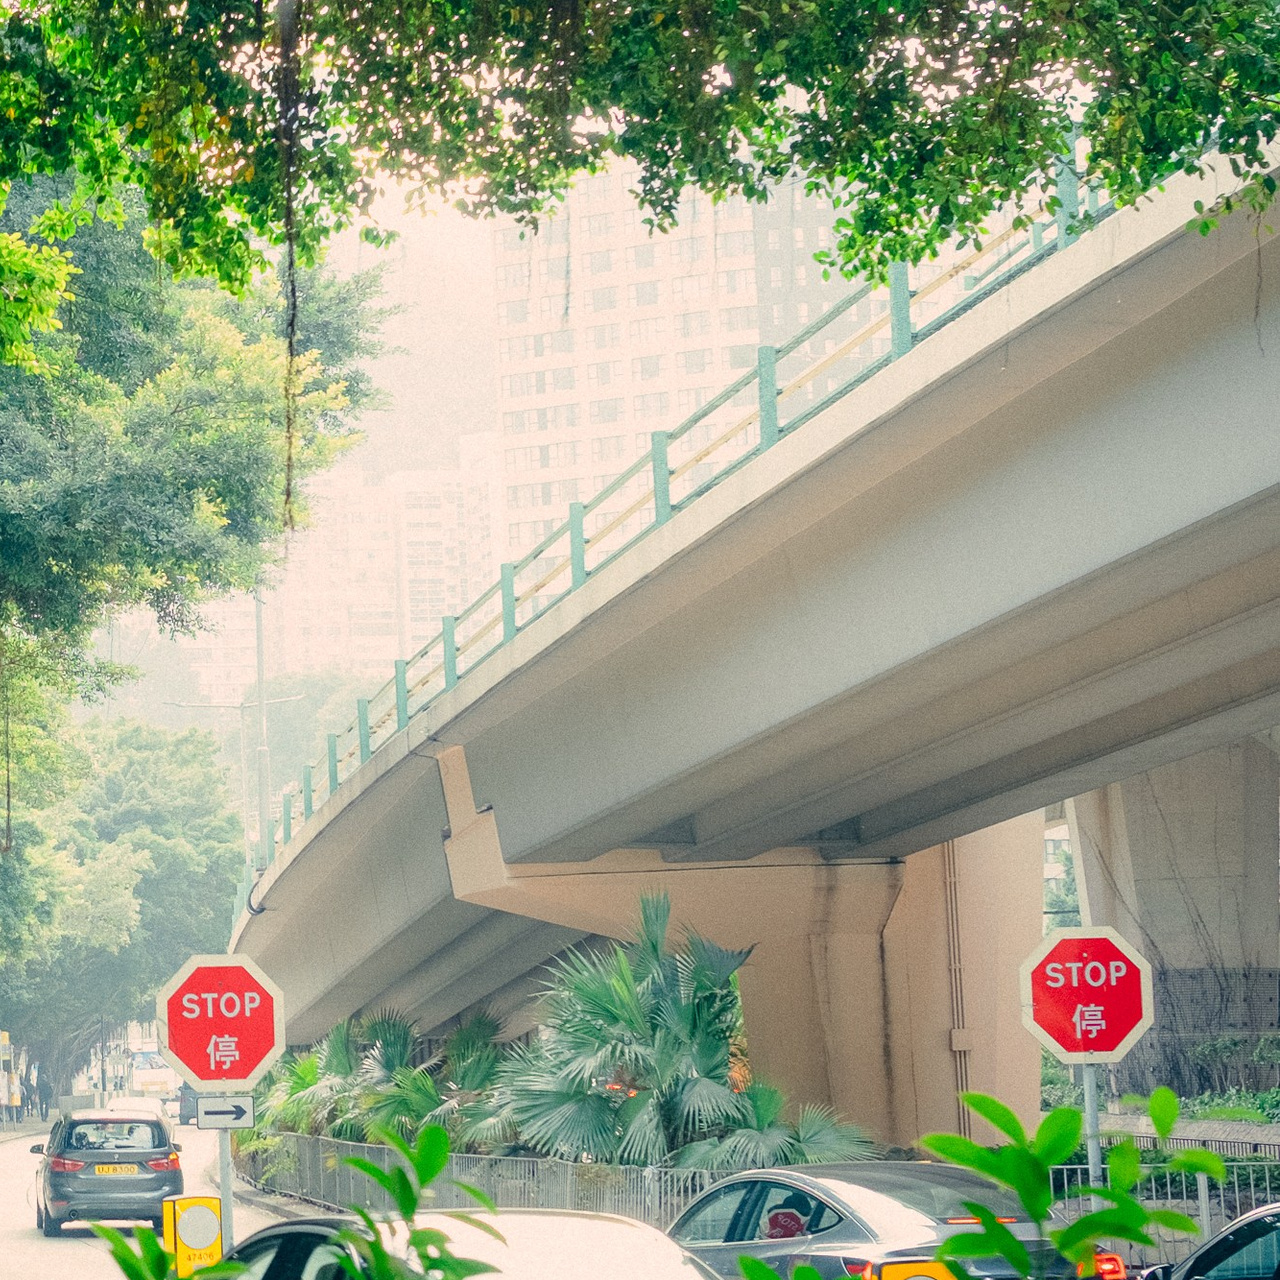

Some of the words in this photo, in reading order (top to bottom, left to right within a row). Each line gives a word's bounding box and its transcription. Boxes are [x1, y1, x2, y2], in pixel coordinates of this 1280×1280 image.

[1045, 960, 1127, 988] STOP
[181, 991, 261, 1019] STOP
[1071, 1003, 1107, 1039] 停
[205, 1033, 240, 1071] 停
